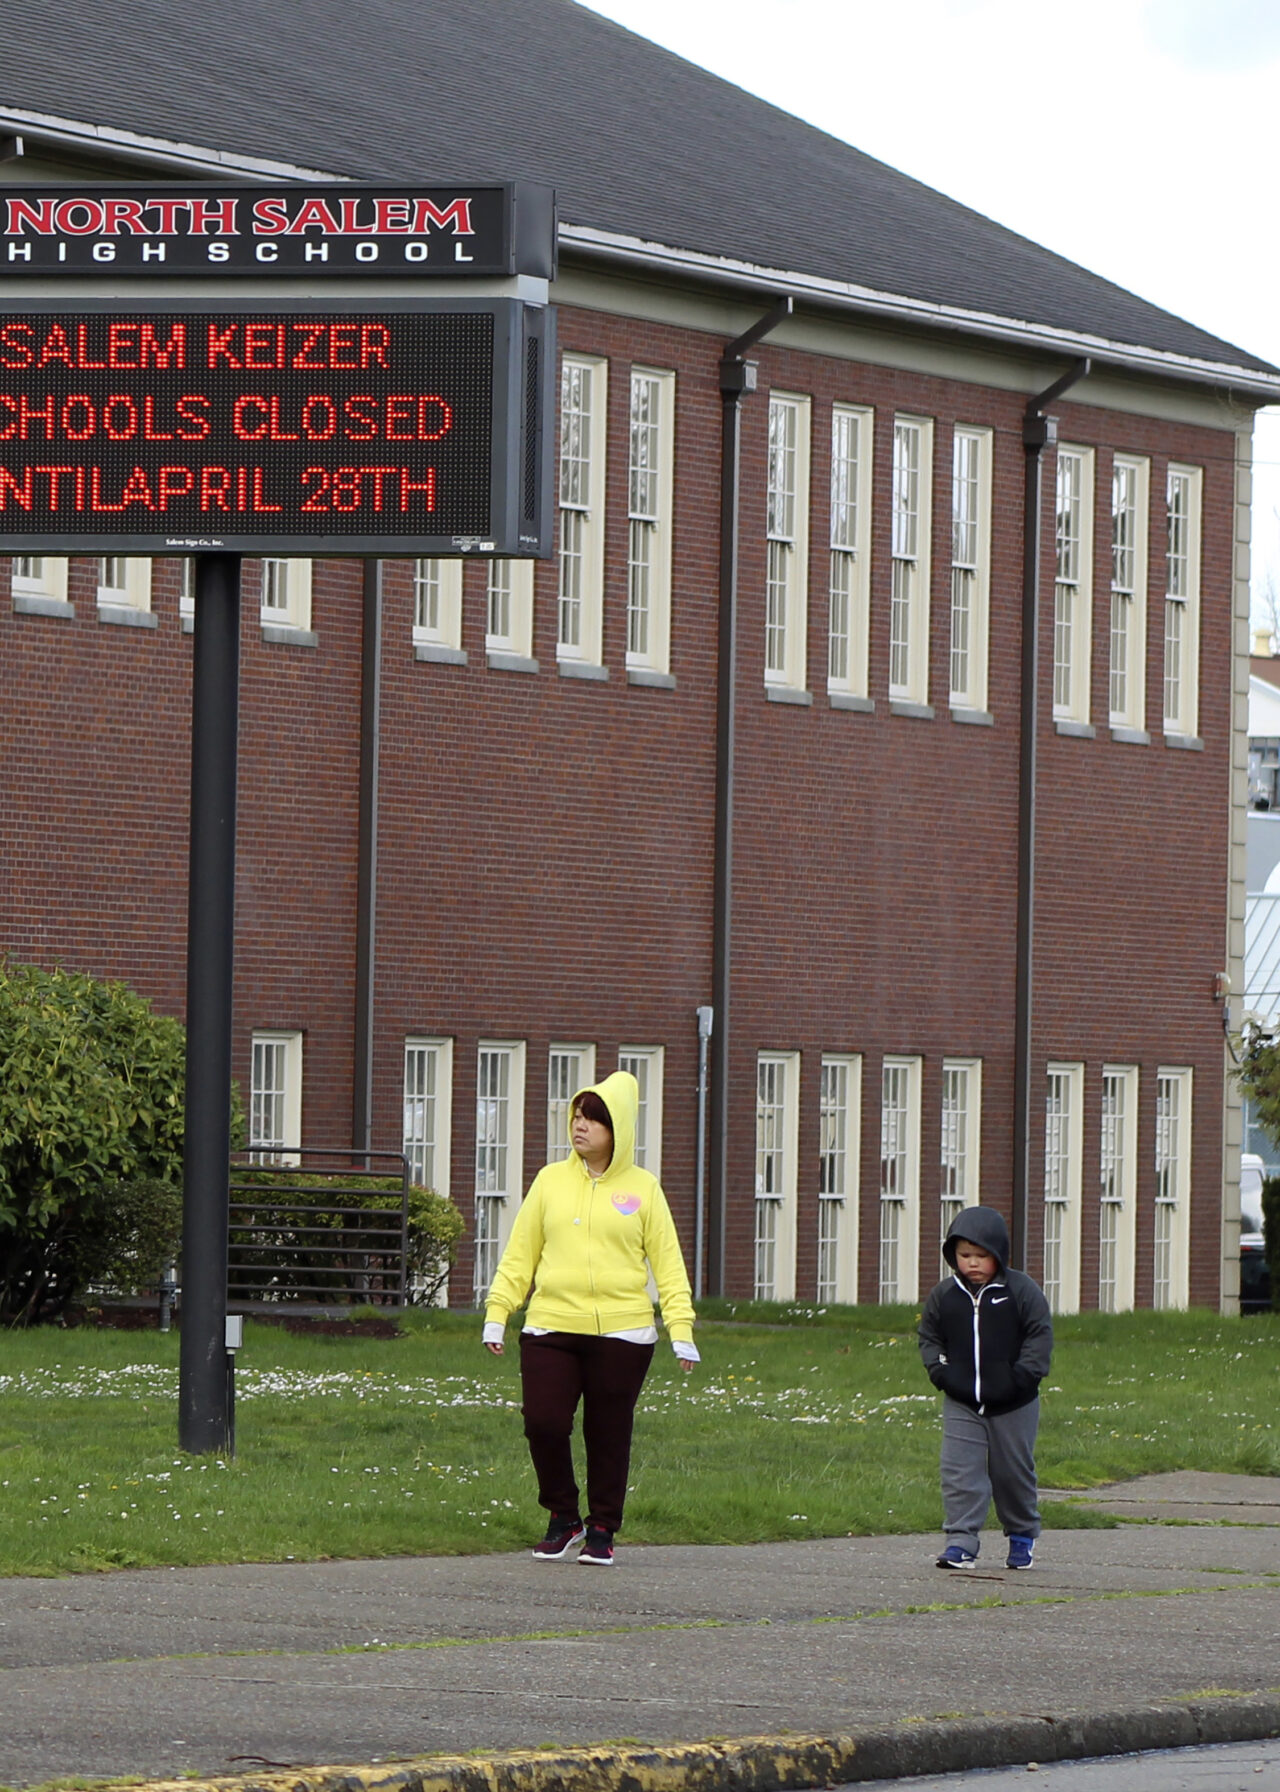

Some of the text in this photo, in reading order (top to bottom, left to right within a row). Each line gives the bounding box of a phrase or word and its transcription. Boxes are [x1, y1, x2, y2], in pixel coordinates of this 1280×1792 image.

[4, 198, 476, 236] NORTH SALEM
[8, 242, 474, 262] HIGH SCHOOL
[0, 323, 391, 369] SALEM KEIZER
[233, 395, 453, 440] CLOSED
[300, 466, 436, 512] 28TH
